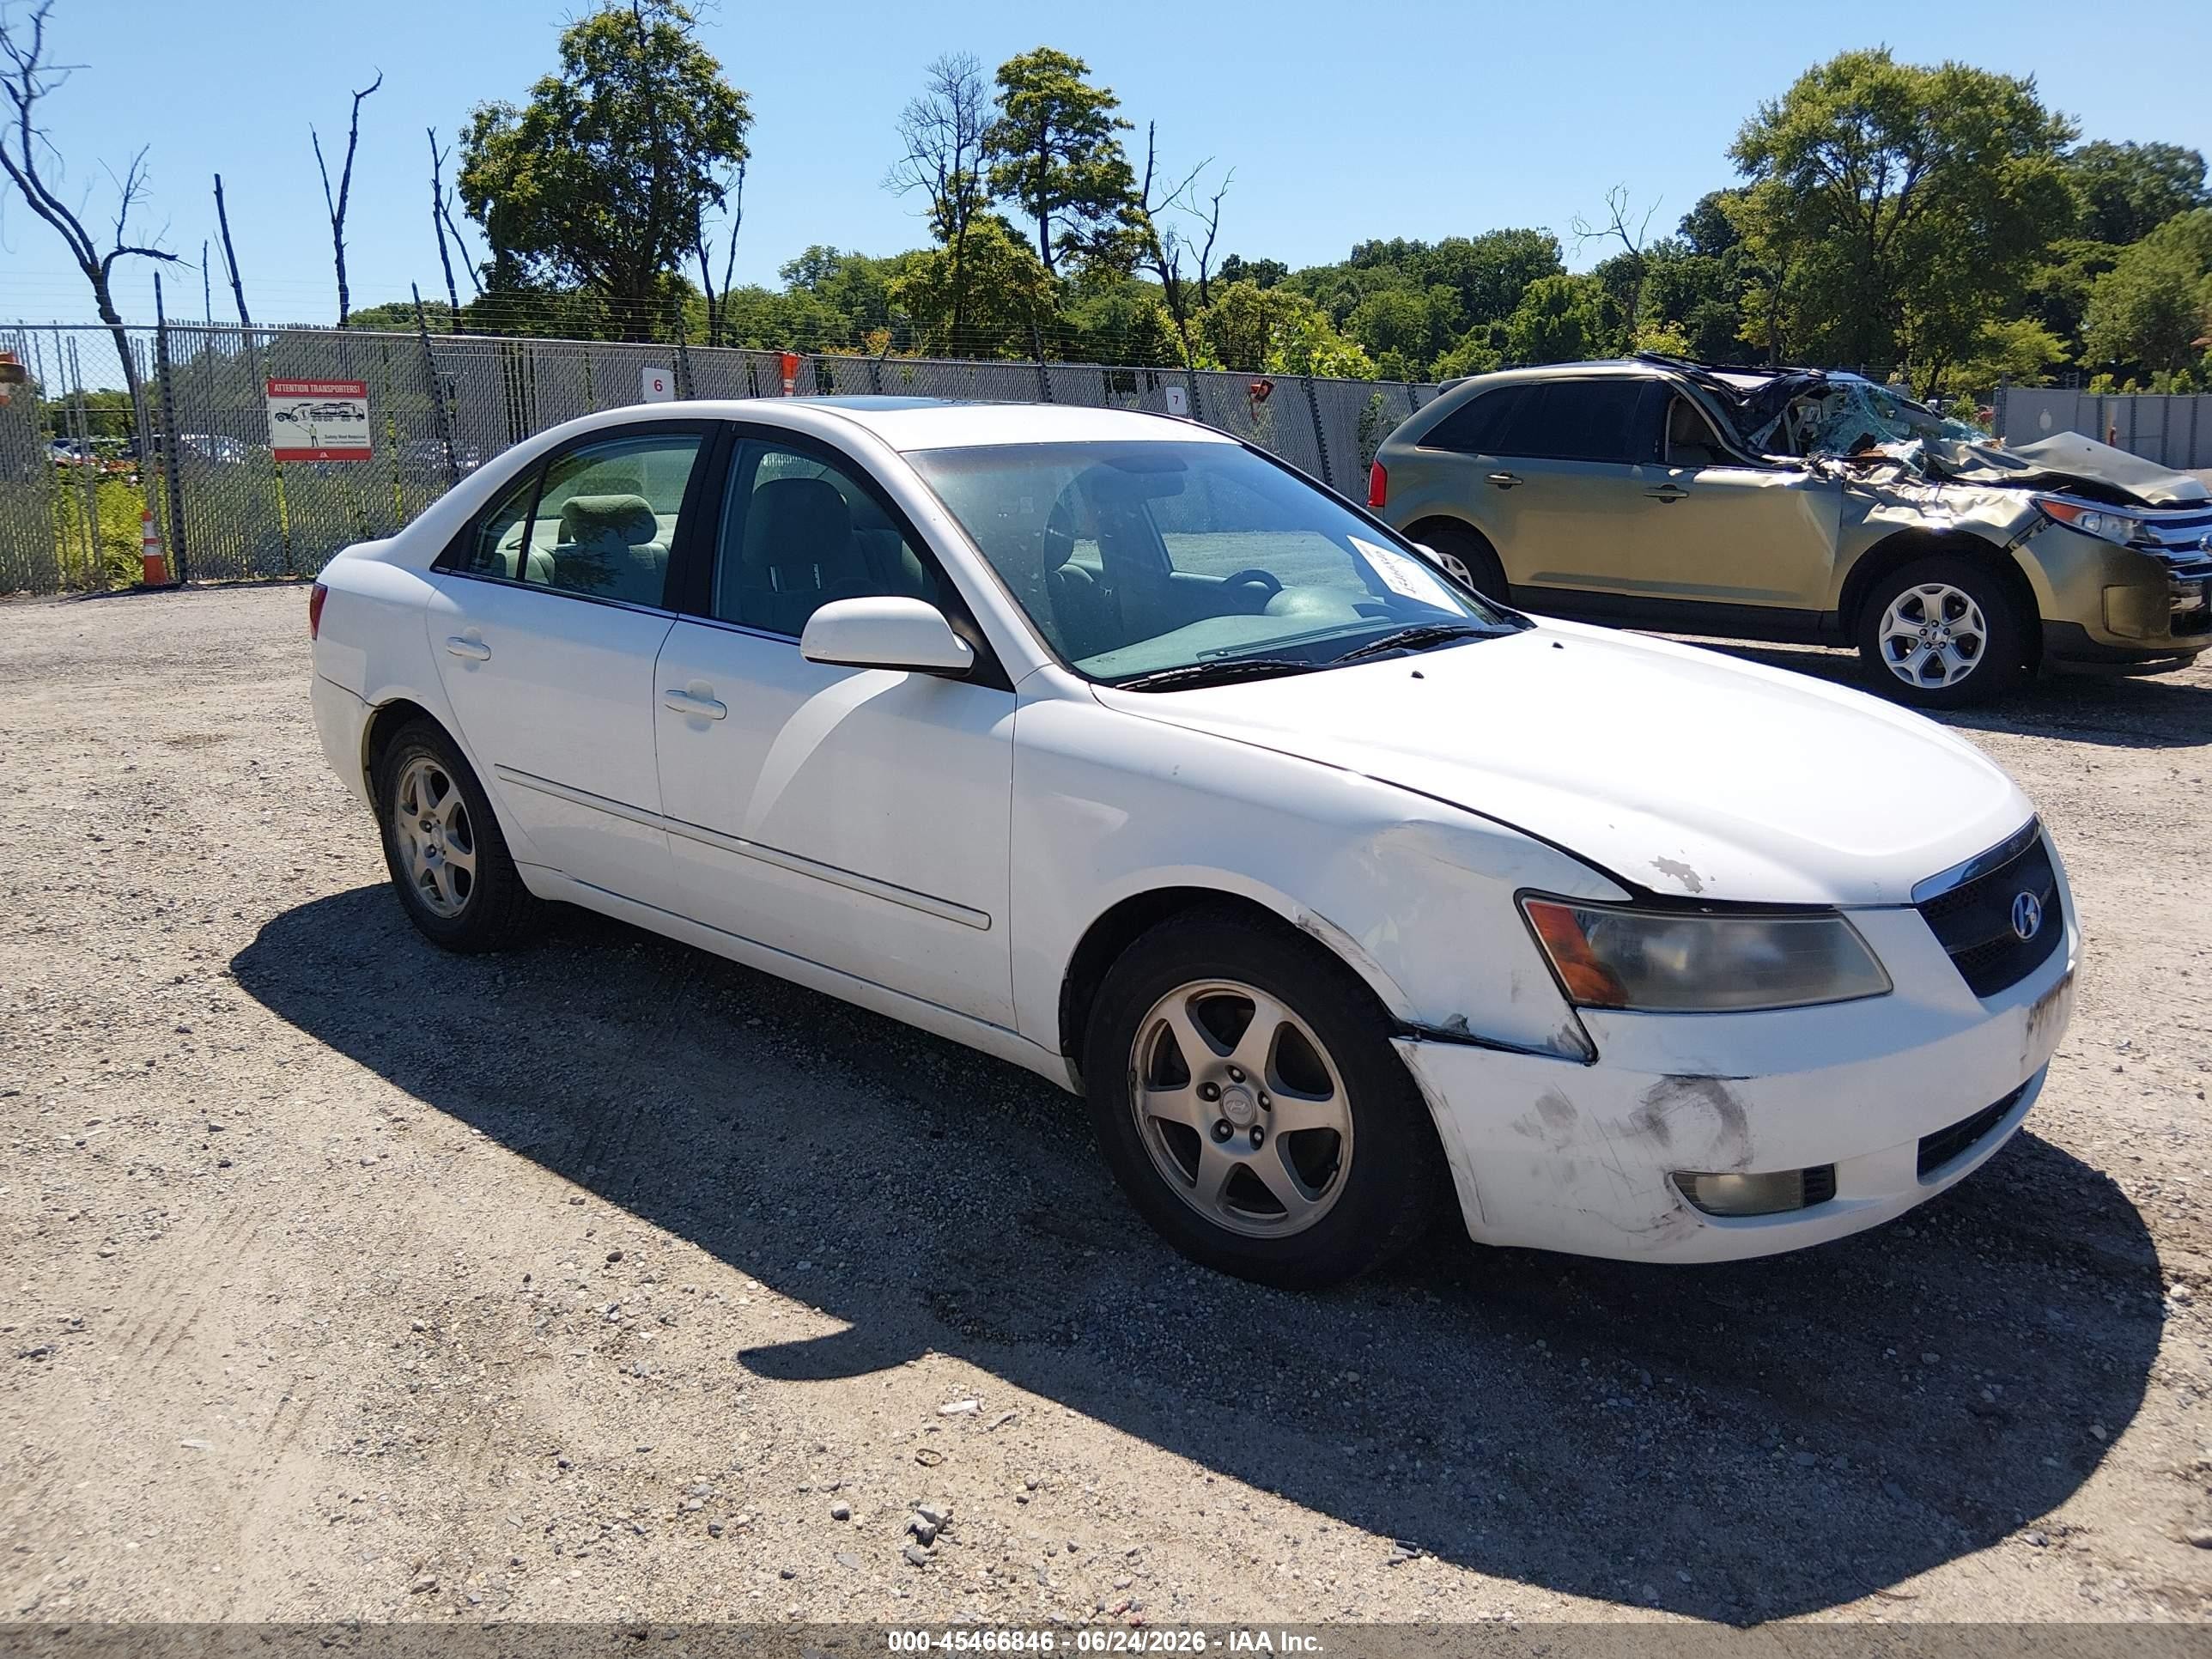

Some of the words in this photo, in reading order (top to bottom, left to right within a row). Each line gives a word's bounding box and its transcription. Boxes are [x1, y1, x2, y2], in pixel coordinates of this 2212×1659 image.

[274, 384, 308, 392] ATTENTION
[310, 384, 361, 393] TRANSPORTERS!
[653, 379, 663, 392] 6
[1173, 395, 1179, 405] 7
